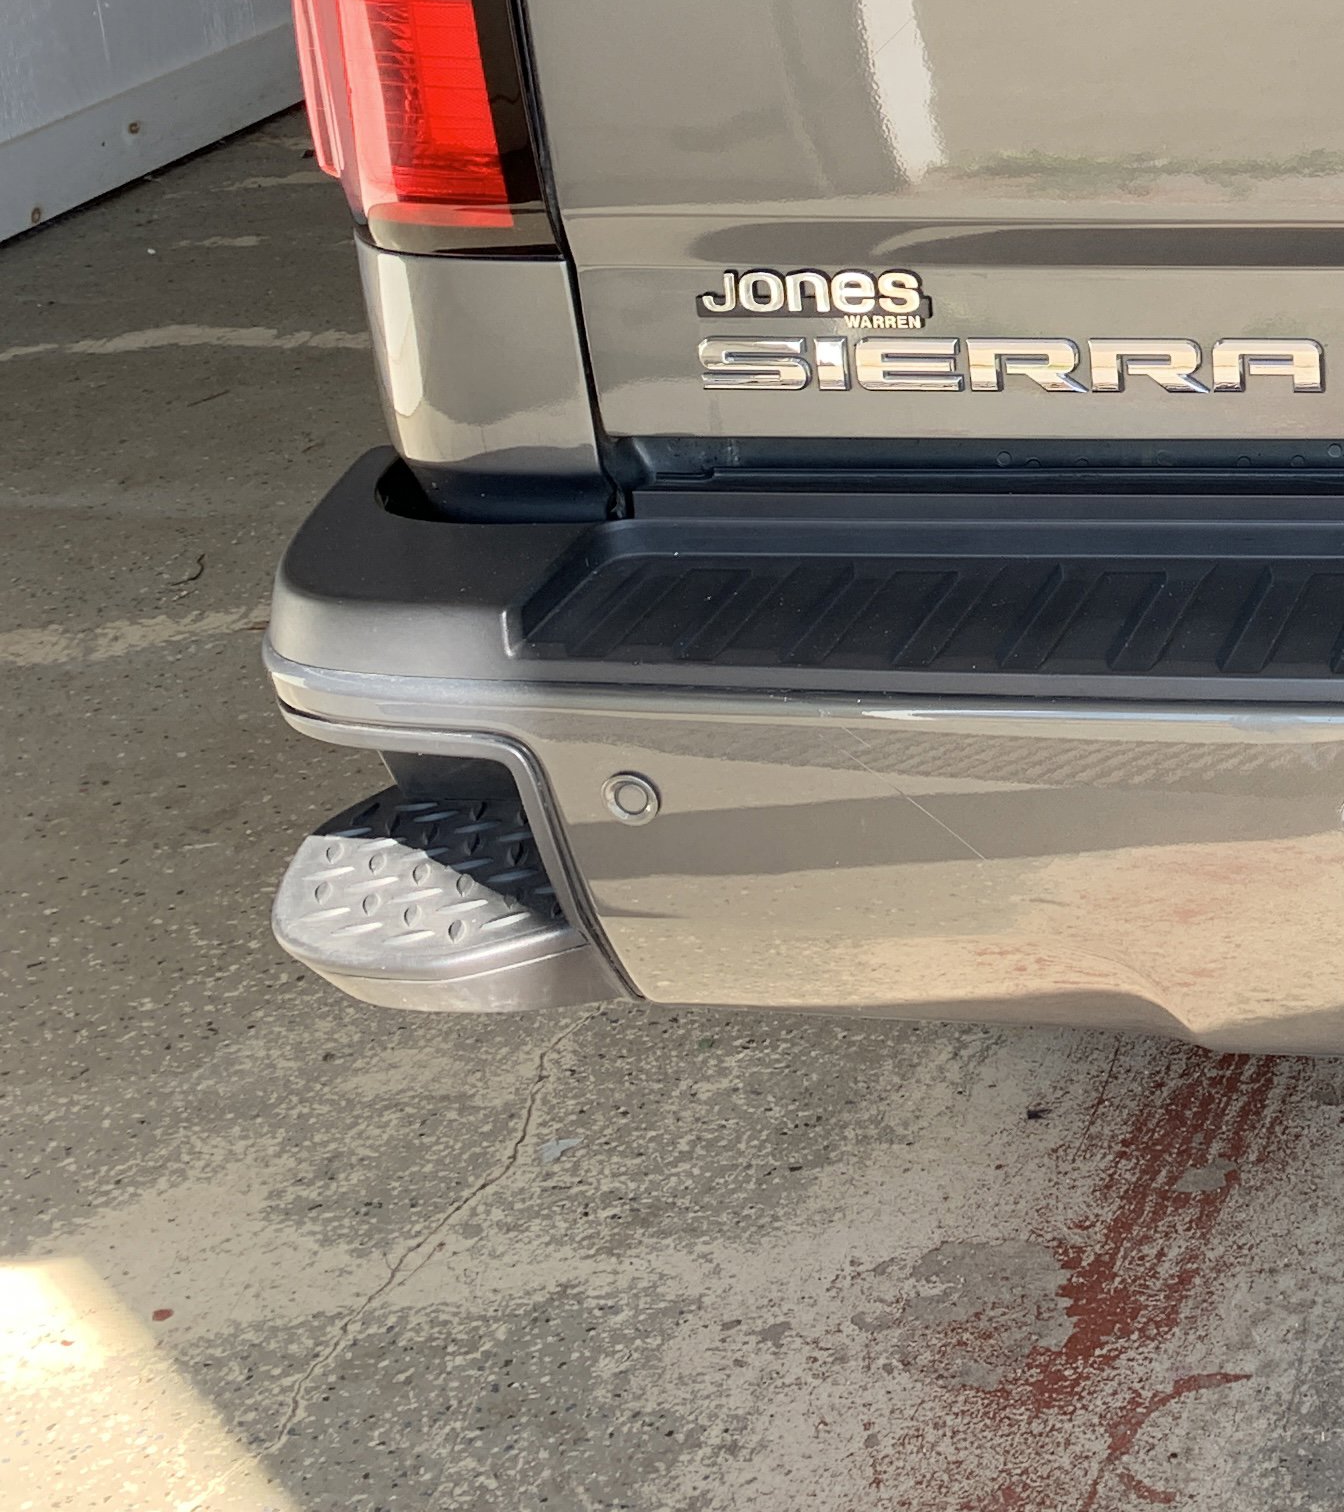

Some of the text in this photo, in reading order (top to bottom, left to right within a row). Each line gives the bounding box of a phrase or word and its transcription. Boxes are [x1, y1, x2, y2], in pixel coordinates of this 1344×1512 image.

[701, 270, 922, 314] Jones
[843, 315, 922, 329] WARREN
[697, 335, 1326, 393] SIERRA
